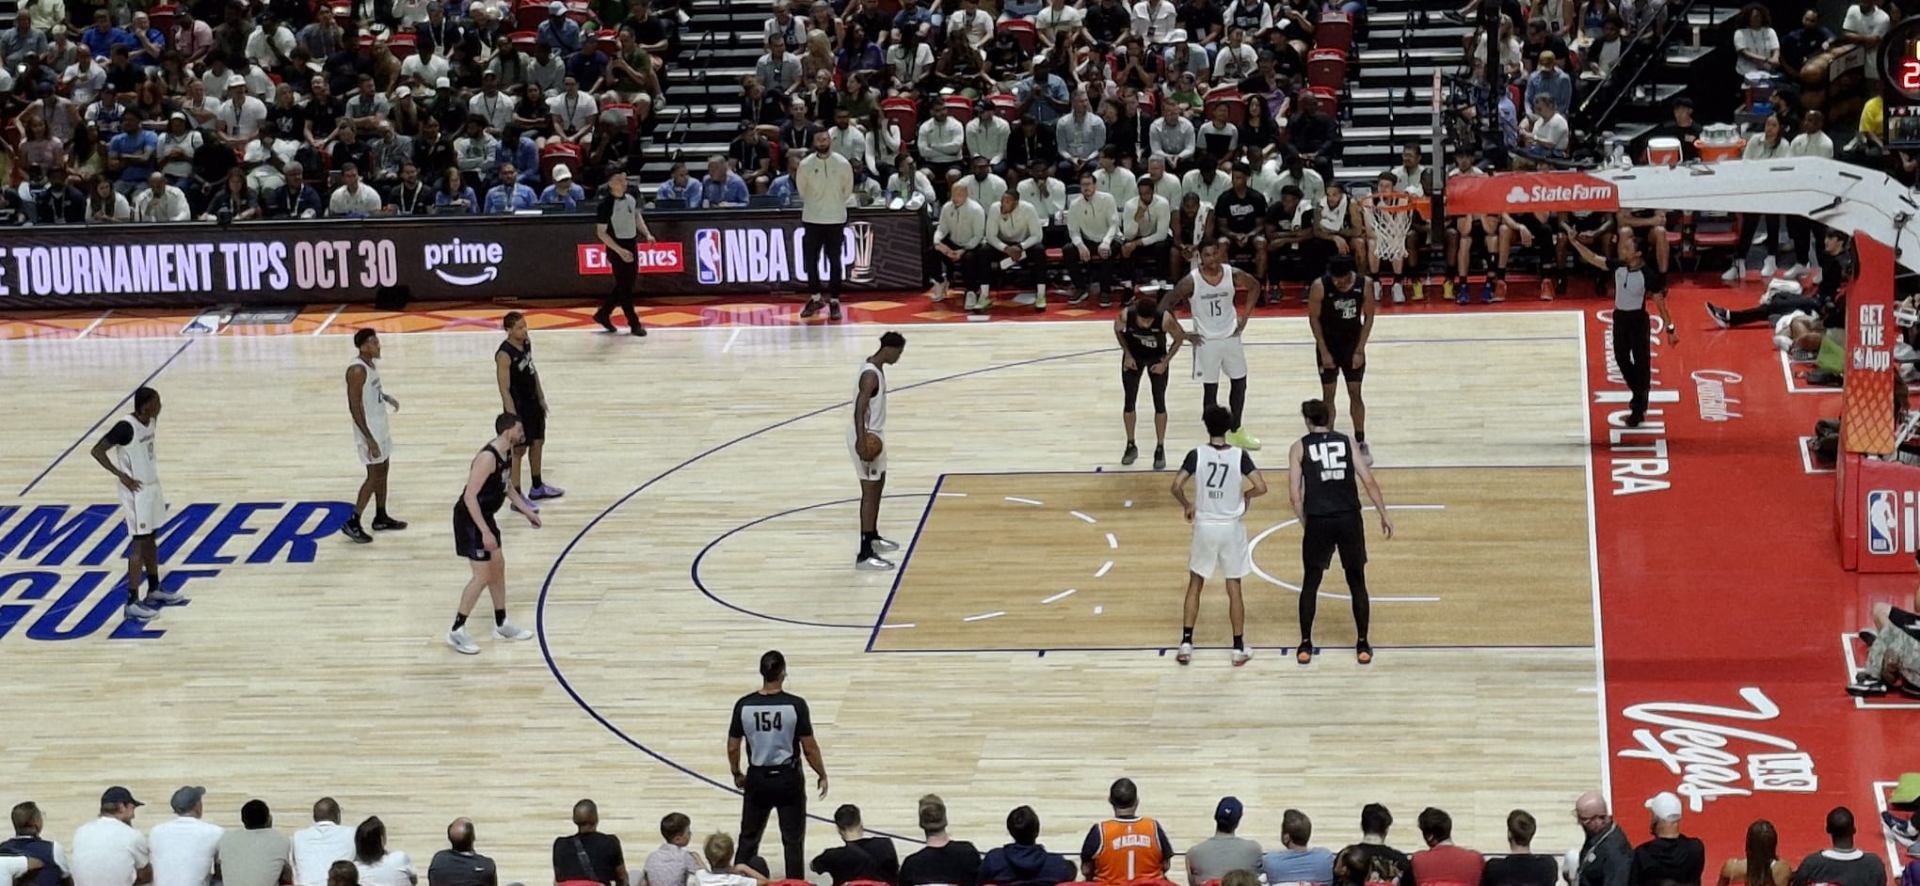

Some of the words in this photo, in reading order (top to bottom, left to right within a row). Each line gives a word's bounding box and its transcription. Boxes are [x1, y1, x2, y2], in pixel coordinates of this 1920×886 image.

[1531, 185, 1571, 202] State
[1573, 184, 1611, 200] Farm
[13, 243, 215, 296] TOURNAMENT
[219, 241, 289, 290] TIPS
[294, 240, 352, 289] OCT
[358, 239, 397, 287] 30
[424, 238, 503, 270] prime
[585, 248, 677, 268] Eates
[725, 227, 790, 283] NBA
[1210, 300, 1222, 317] 15
[1860, 304, 1885, 325] GET
[1860, 325, 1885, 346] THE
[1865, 347, 1890, 372] App
[1308, 441, 1347, 470] 42
[1608, 409, 1671, 496] ULTRA
[1206, 462, 1229, 488] 27
[753, 711, 783, 732] 154
[1617, 687, 1798, 812] Vegas
[1758, 757, 1810, 787] LAS
[1128, 850, 1135, 880] 1
